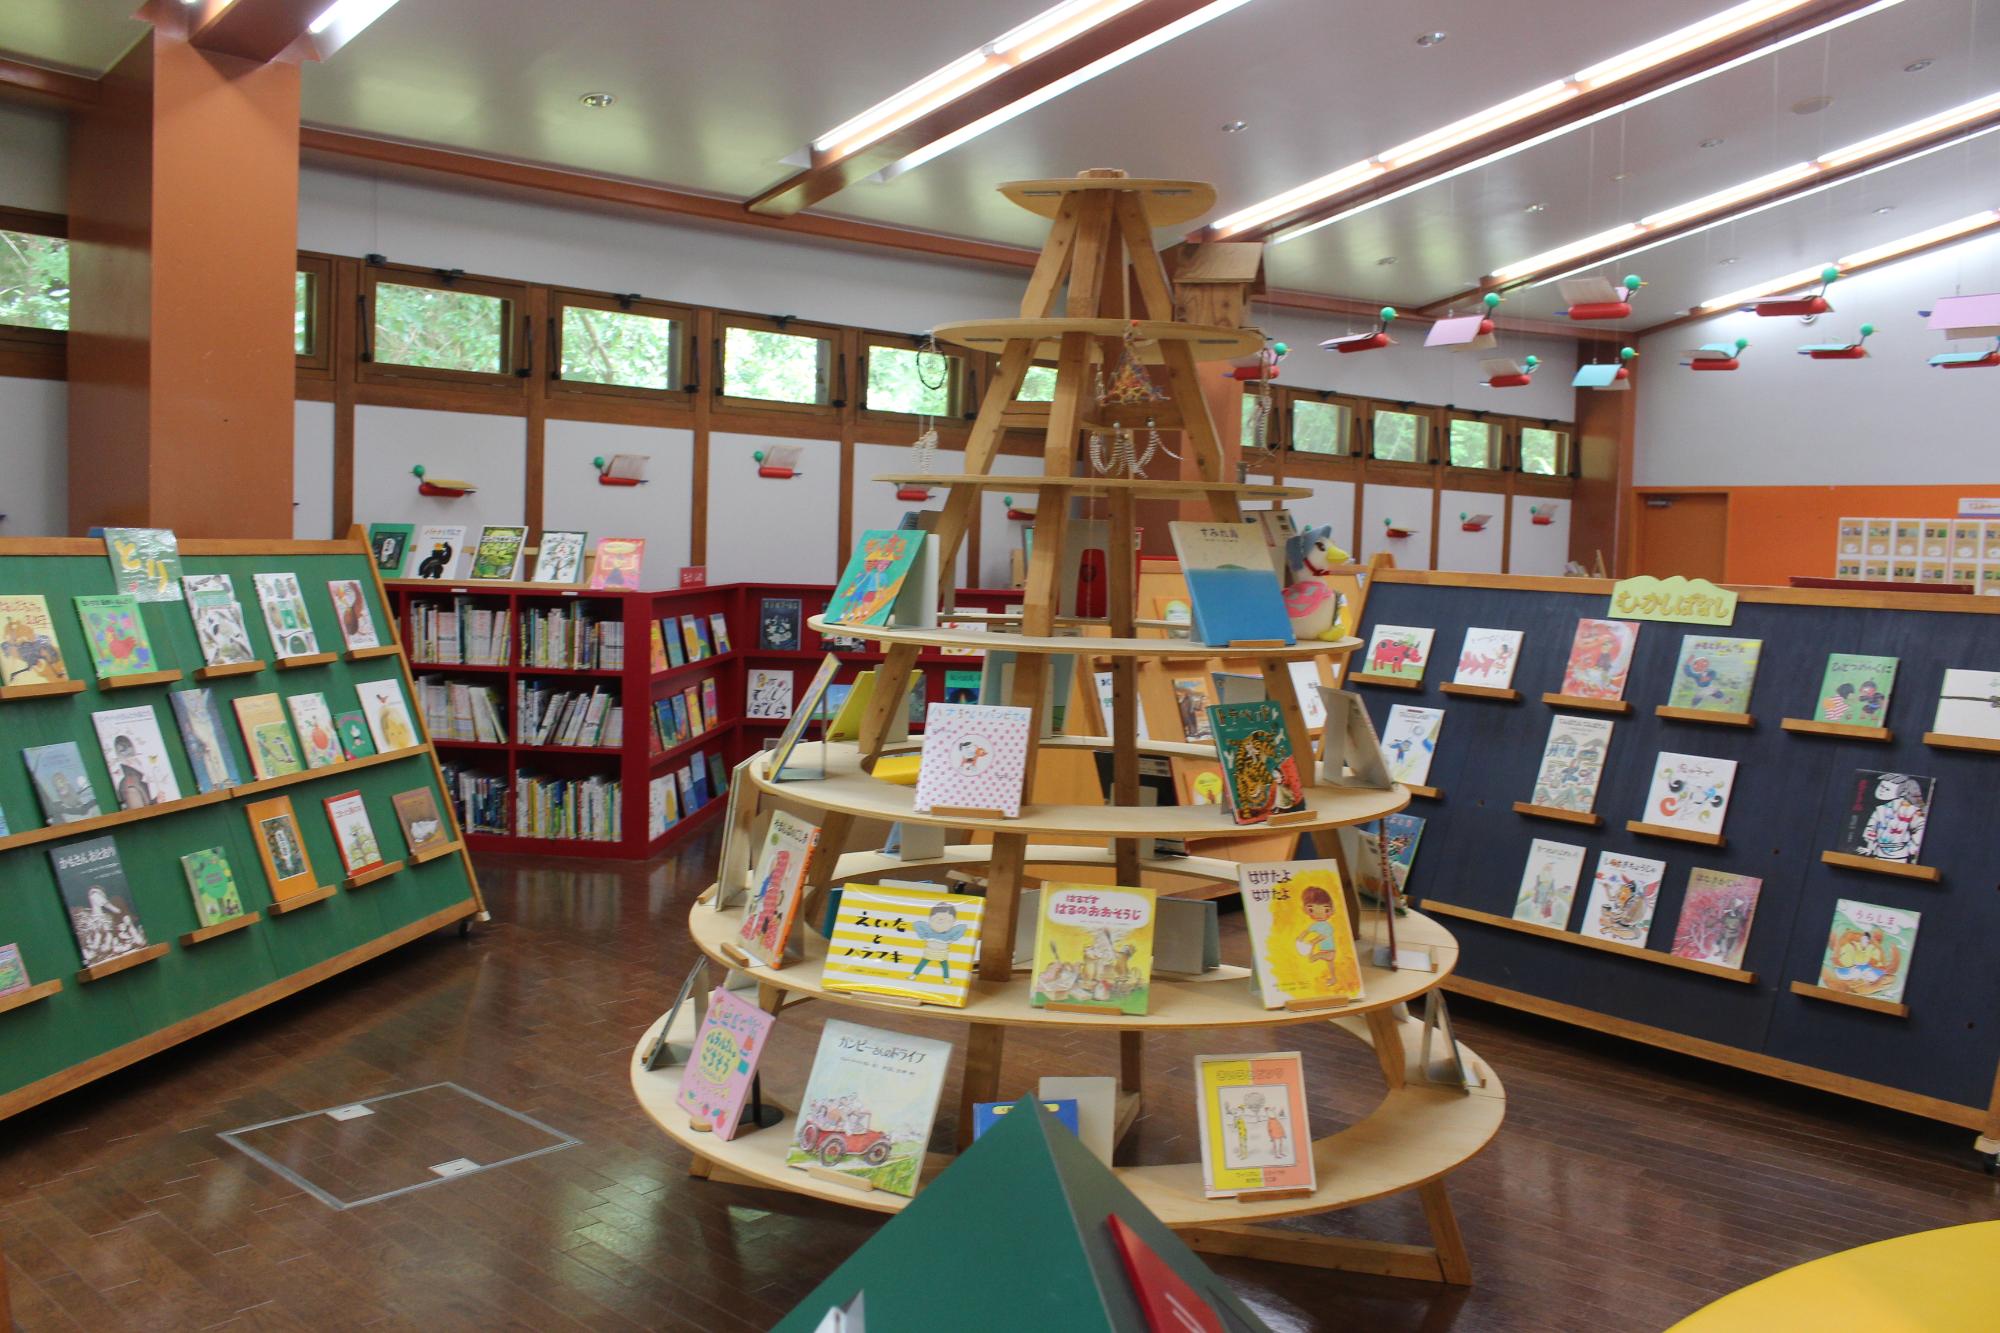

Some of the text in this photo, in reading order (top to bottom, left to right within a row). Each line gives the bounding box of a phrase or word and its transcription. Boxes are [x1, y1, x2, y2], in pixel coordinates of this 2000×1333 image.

[113, 539, 169, 593] とり
[1616, 590, 1730, 618] むかしばなし
[1247, 869, 1292, 885] はけたよ
[1065, 894, 1099, 905] はるです
[1251, 889, 1291, 902] はけたよ
[1054, 903, 1142, 921] はるのおおそうじ
[855, 910, 907, 933] えいた
[872, 933, 883, 945] と
[843, 946, 903, 964] ハラマキ
